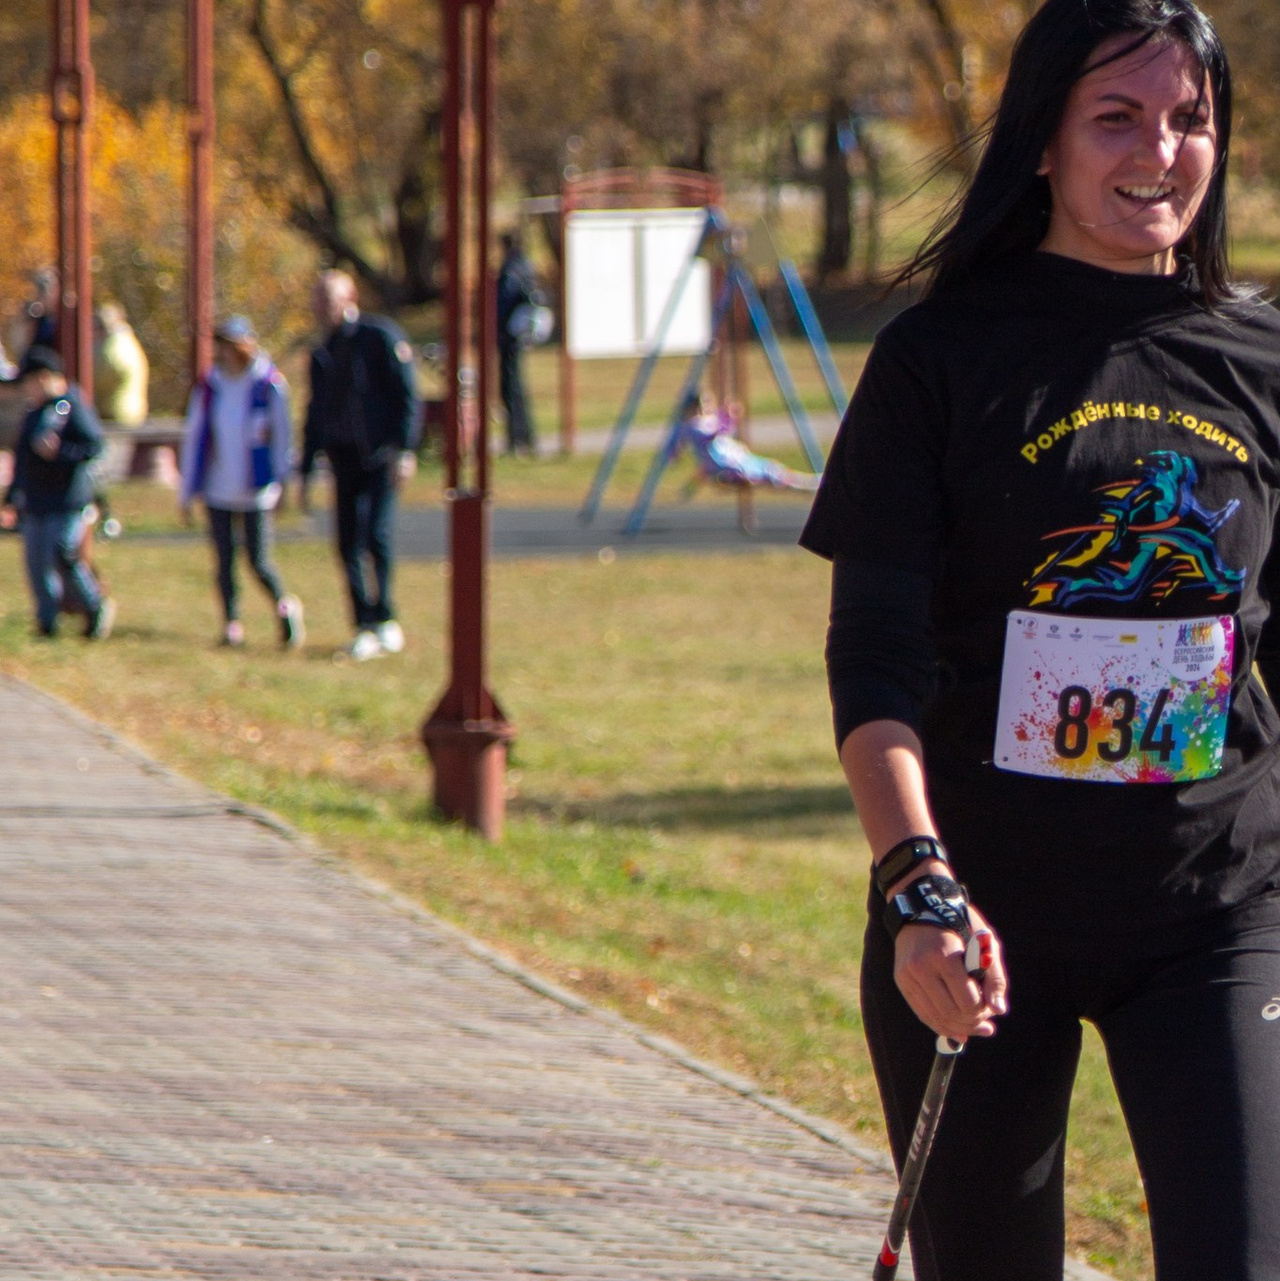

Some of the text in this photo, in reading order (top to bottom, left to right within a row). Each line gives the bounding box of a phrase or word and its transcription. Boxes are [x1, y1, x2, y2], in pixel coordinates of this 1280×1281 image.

[1020, 401, 1249, 464] Рождённые ходить
[1186, 664, 1200, 672] 2024
[1054, 685, 1176, 763] 834
[917, 883, 957, 918] LEKI
